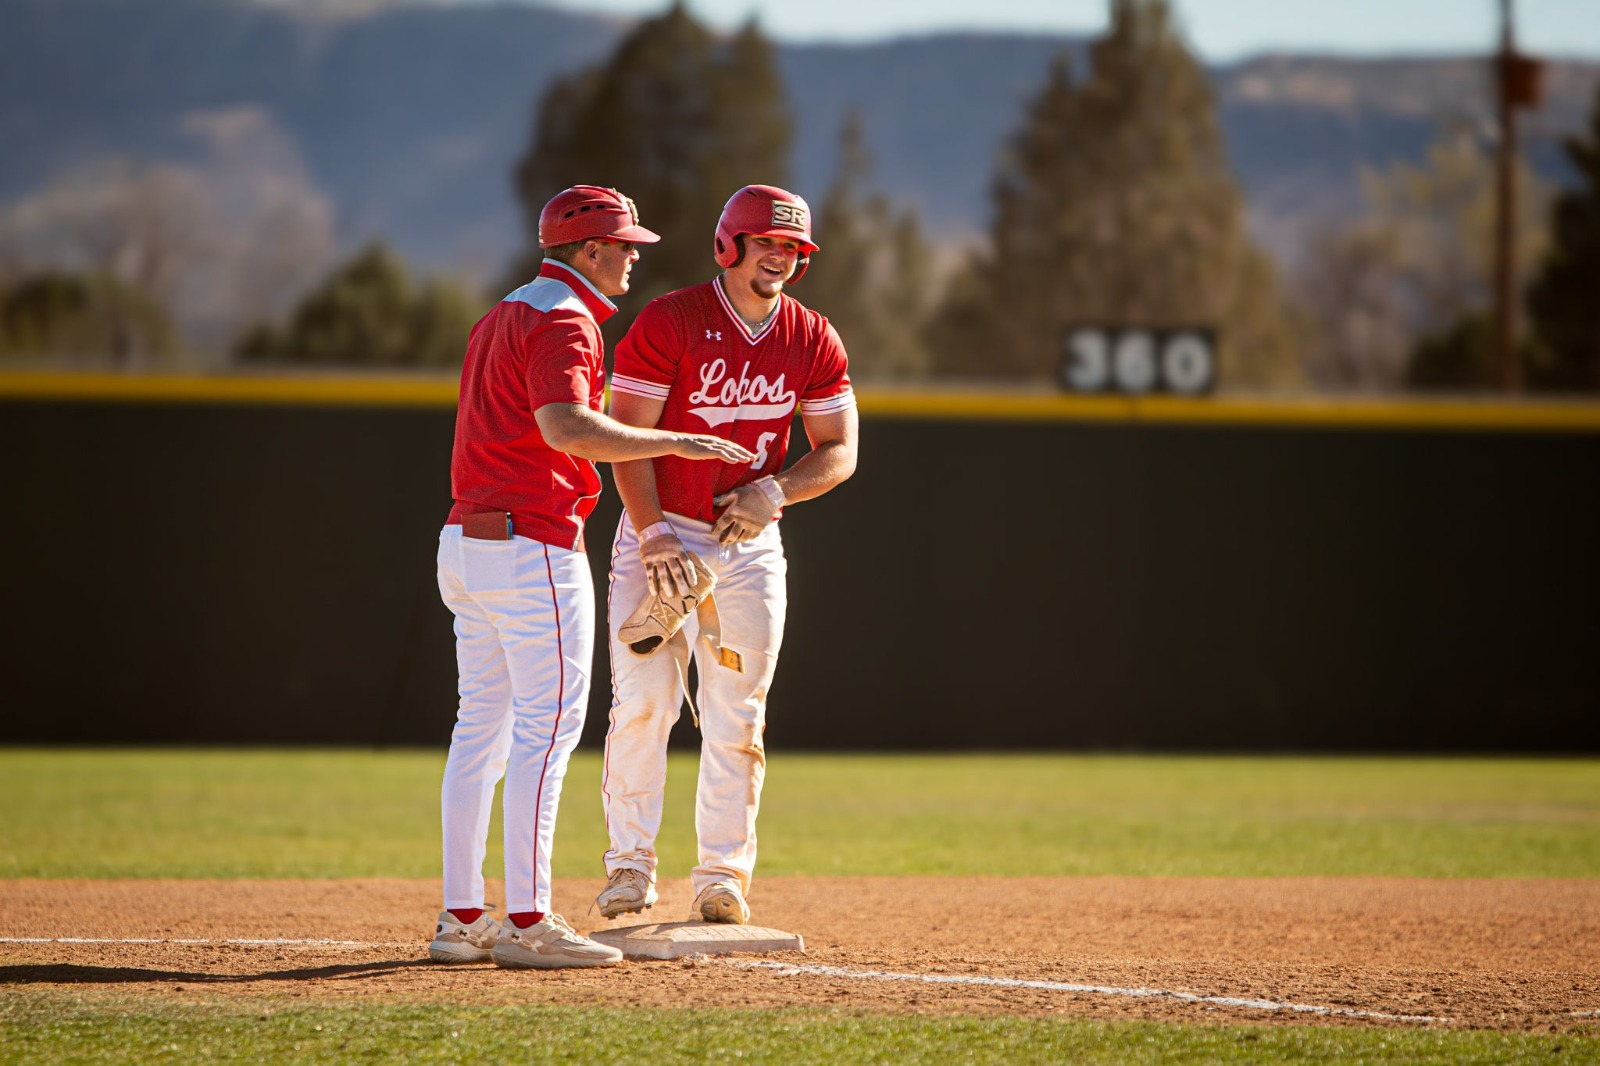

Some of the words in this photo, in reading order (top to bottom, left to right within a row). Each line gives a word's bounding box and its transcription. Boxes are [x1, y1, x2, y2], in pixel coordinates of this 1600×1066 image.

[774, 205, 806, 227] SR
[688, 358, 795, 406] Lobos
[1066, 328, 1212, 393] 360
